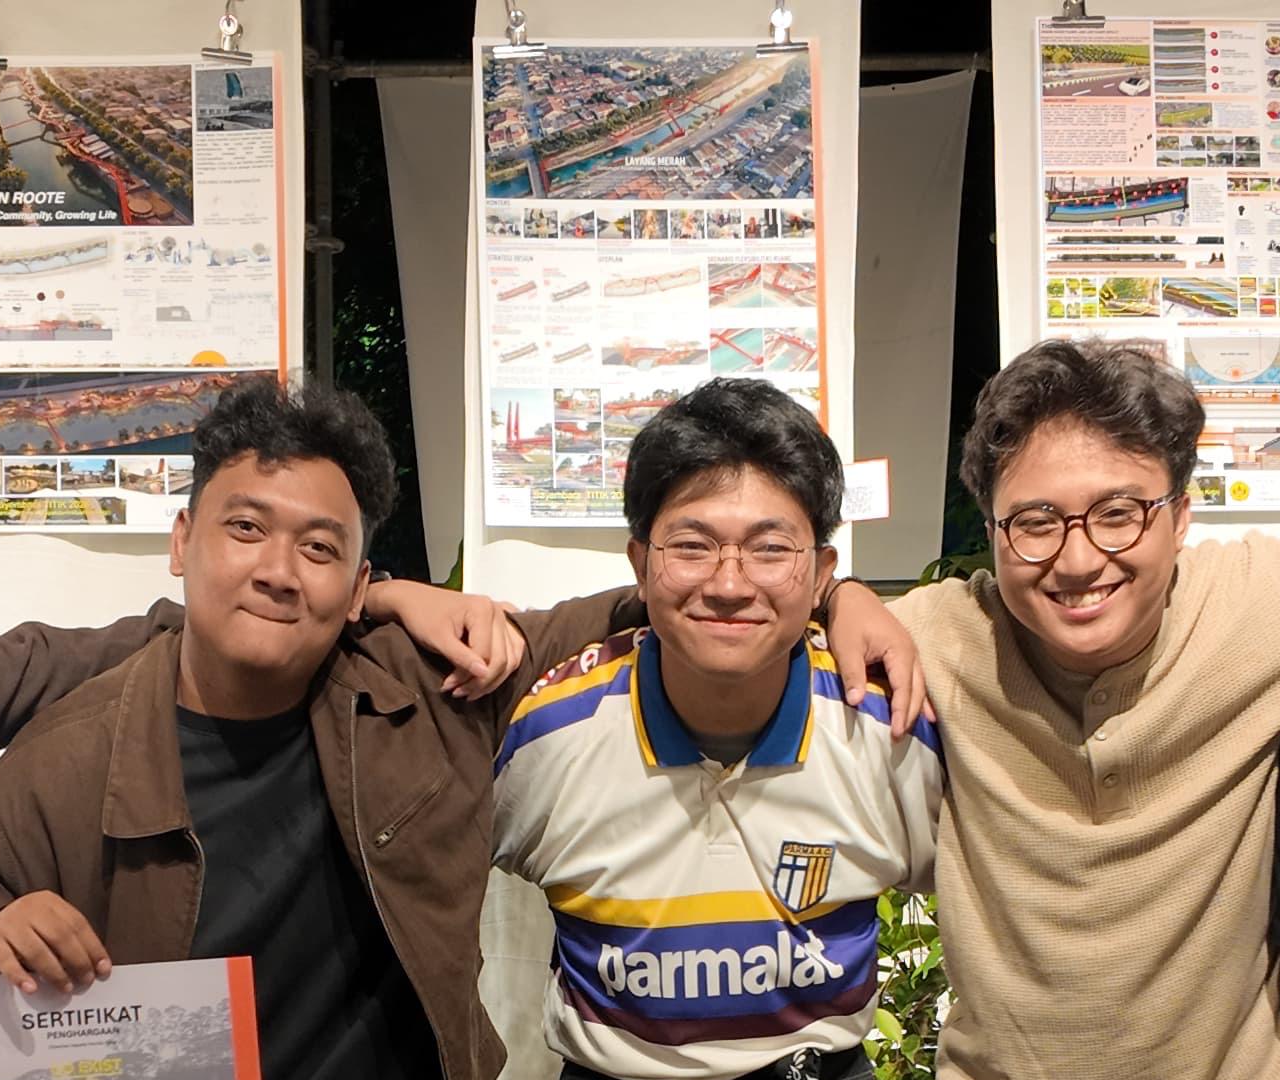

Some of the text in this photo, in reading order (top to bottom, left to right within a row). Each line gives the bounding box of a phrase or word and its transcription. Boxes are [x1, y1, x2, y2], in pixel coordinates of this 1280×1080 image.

[12, 191, 66, 204] ROOTE
[55, 210, 96, 222] Growing
[98, 209, 117, 220] Life
[21, 1005, 143, 1030] SERTIFIKAT
[47, 1027, 120, 1040] PENGHARGAAN
